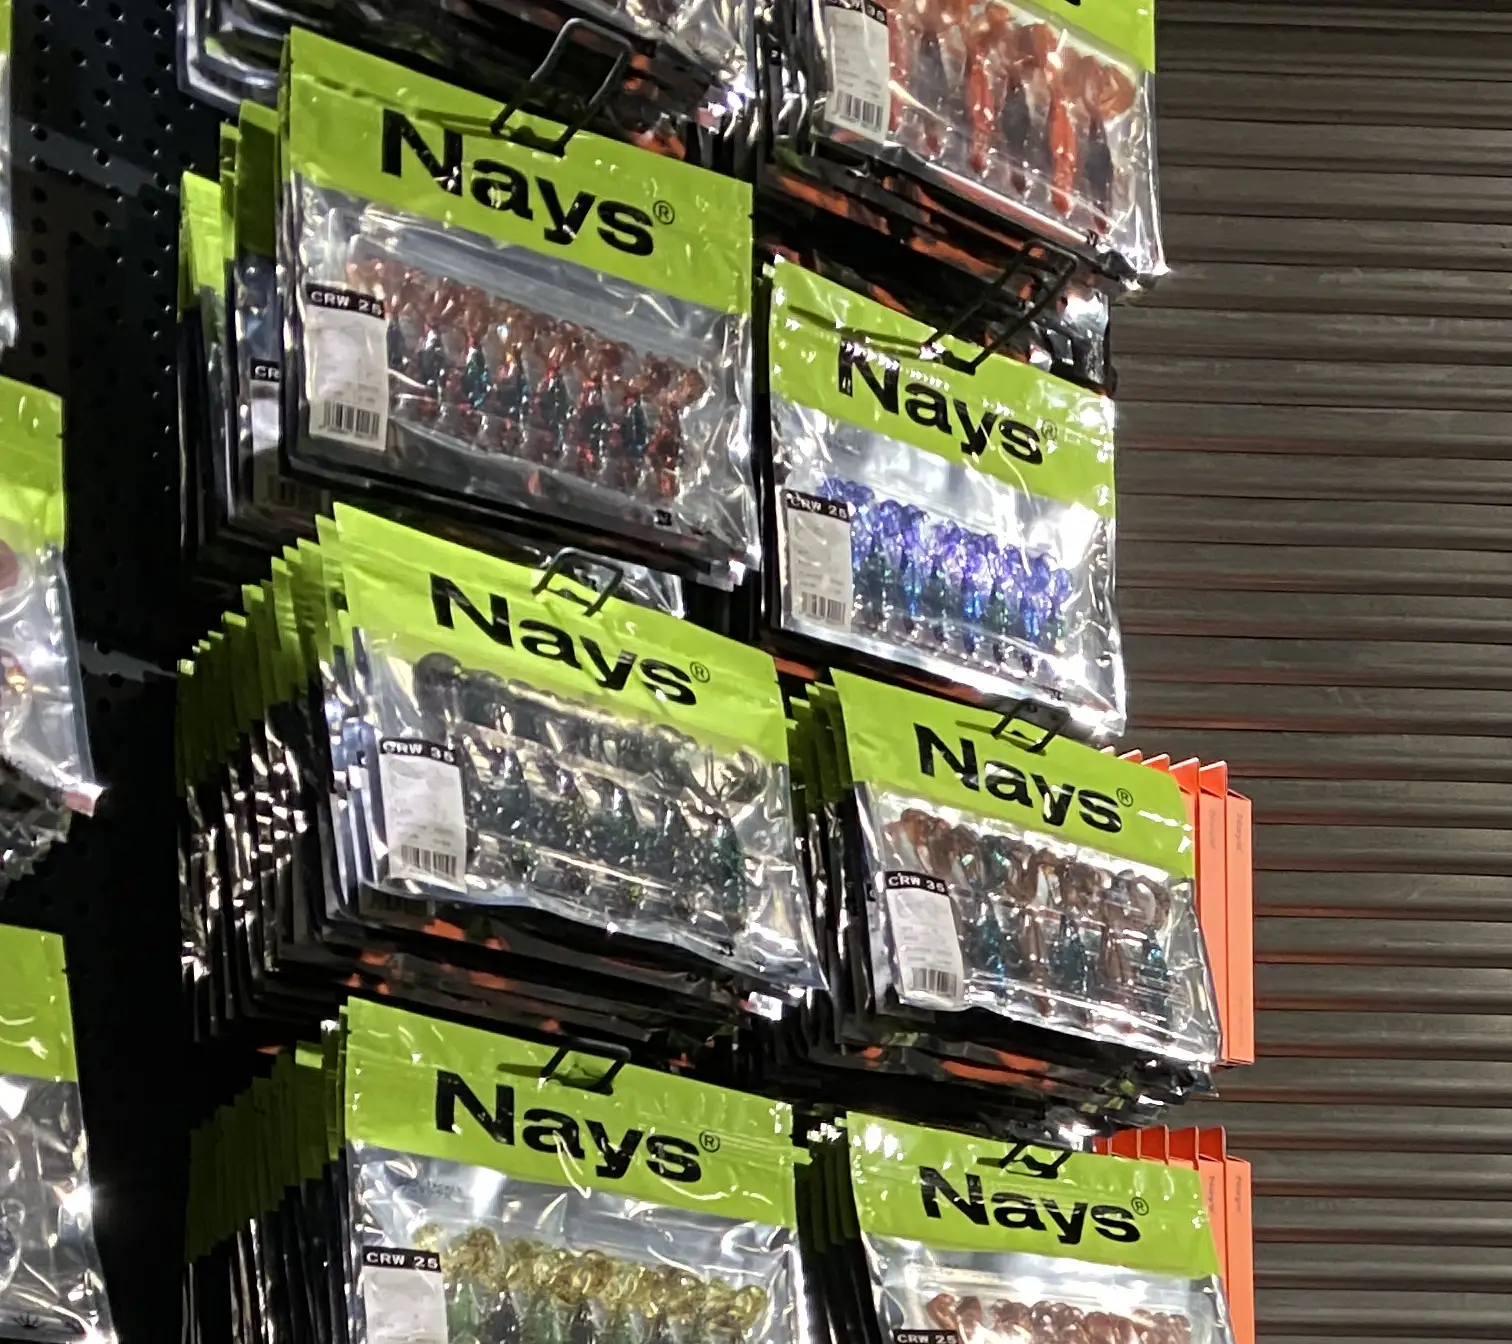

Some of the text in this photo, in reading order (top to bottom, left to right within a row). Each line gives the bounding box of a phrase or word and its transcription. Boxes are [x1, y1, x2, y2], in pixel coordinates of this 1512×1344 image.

[310, 290, 382, 316] CRW 25
[254, 365, 280, 379] CR
[789, 496, 849, 519] CRW 25
[382, 740, 455, 763] CRW 35
[888, 874, 946, 893] CRW 35
[366, 1251, 438, 1269] CRW 25
[896, 1334, 957, 1344] CRW 25
